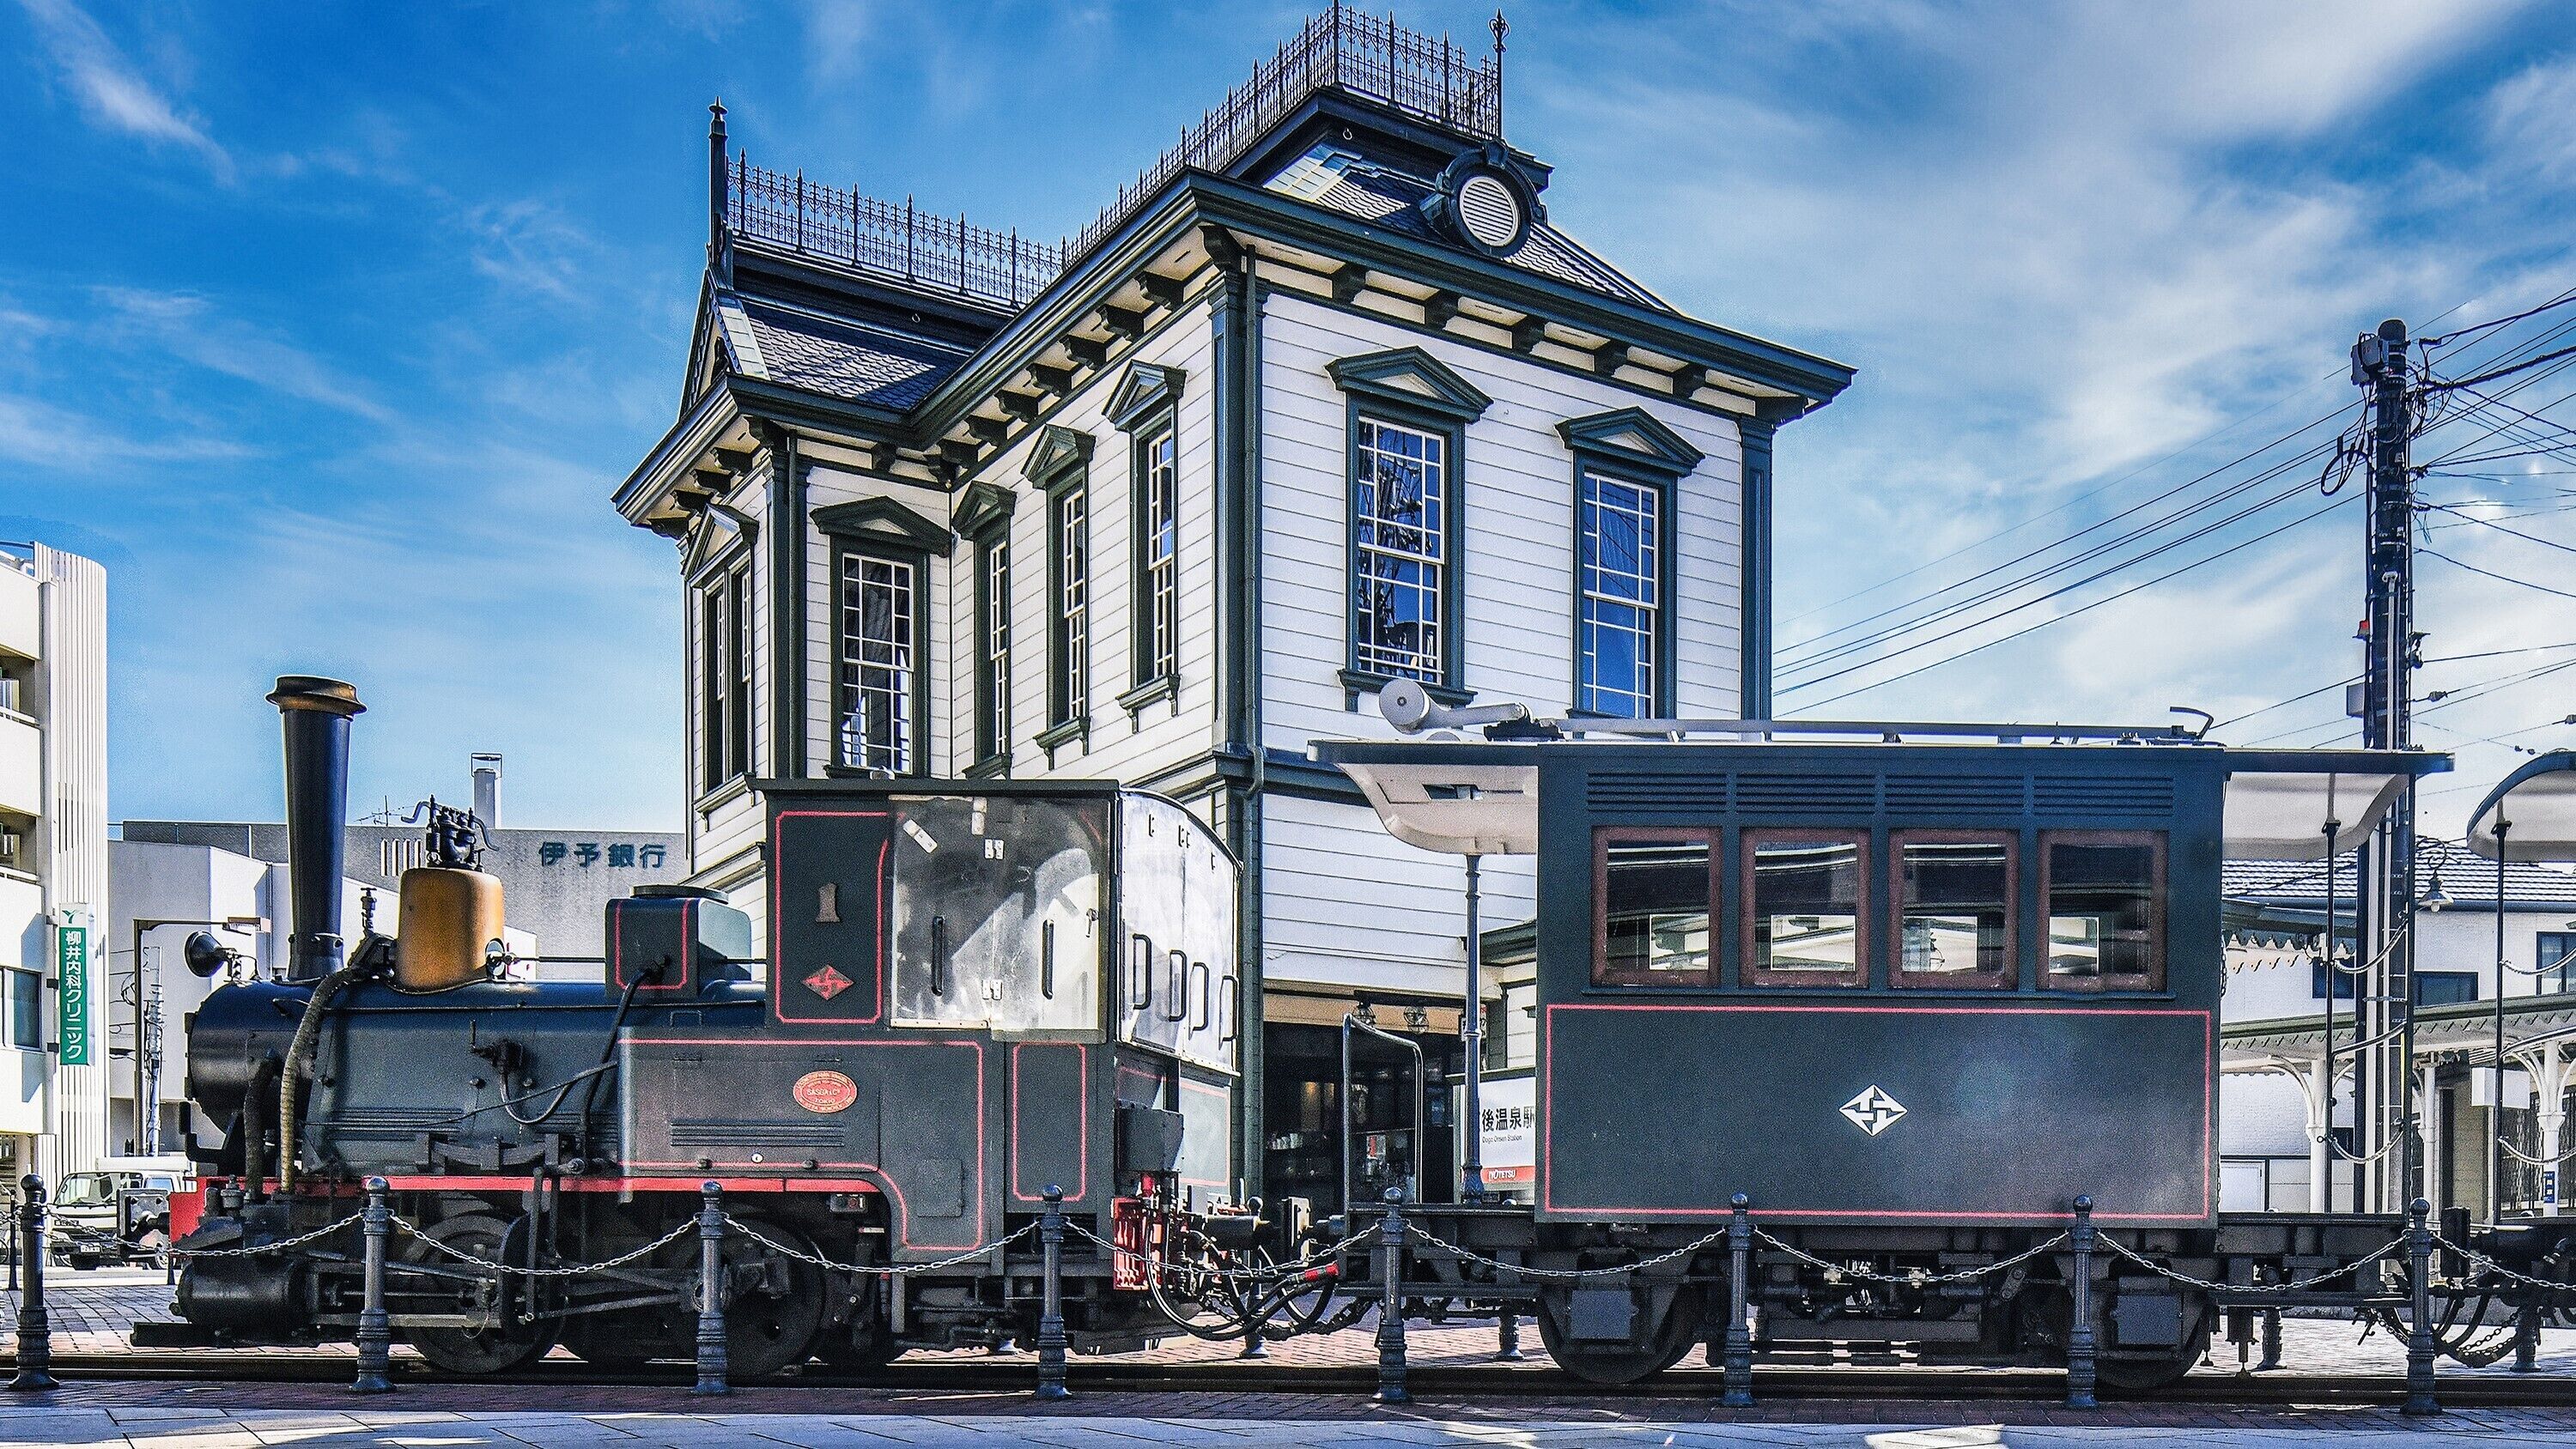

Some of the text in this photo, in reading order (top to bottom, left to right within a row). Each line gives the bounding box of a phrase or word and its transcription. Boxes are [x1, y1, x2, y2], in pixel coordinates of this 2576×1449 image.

[538, 841, 666, 869] 伊予銀行
[815, 882, 841, 923] 1
[65, 931, 82, 1059] 柳井内科クリニック
[1481, 1106, 1535, 1132] 後温泉駅
